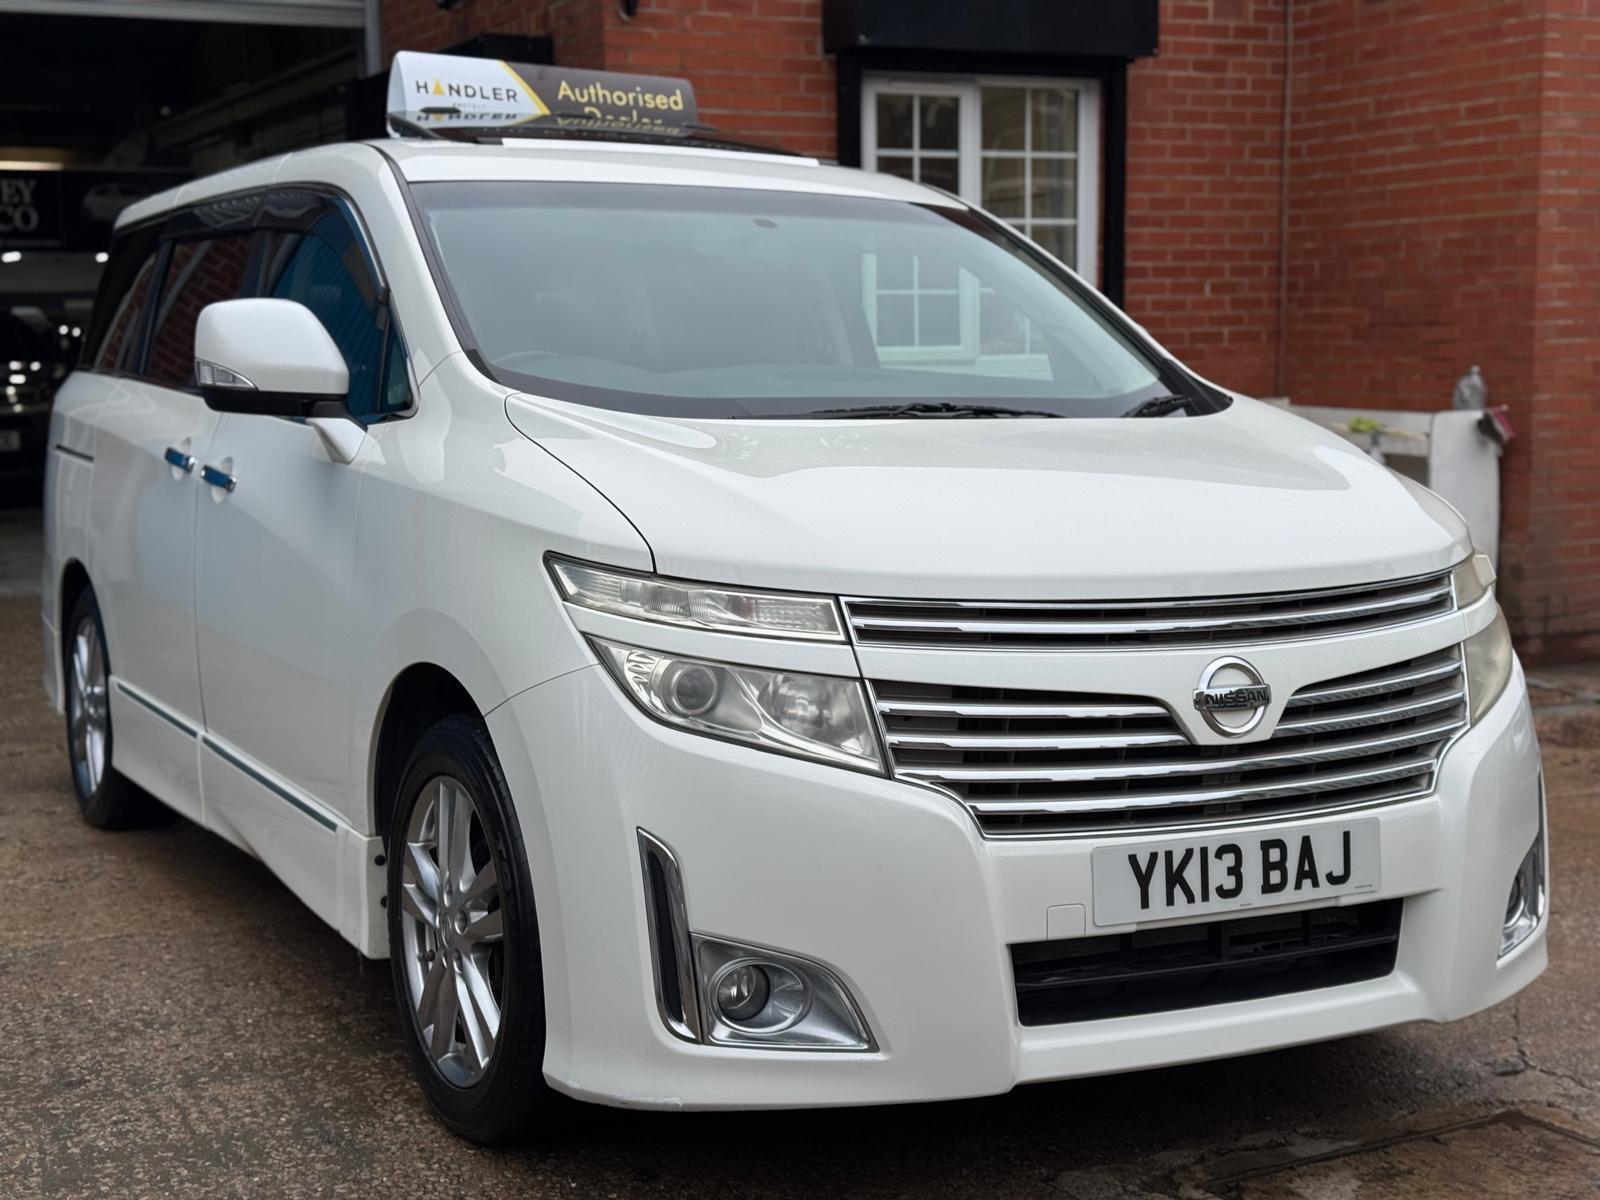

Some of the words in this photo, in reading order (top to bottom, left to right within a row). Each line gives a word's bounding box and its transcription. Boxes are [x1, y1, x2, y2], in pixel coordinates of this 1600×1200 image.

[558, 80, 684, 111] Authorised
[1207, 689, 1267, 708] NISSAN
[1127, 843, 1243, 909] YK13
[1260, 830, 1351, 895] BAJ
